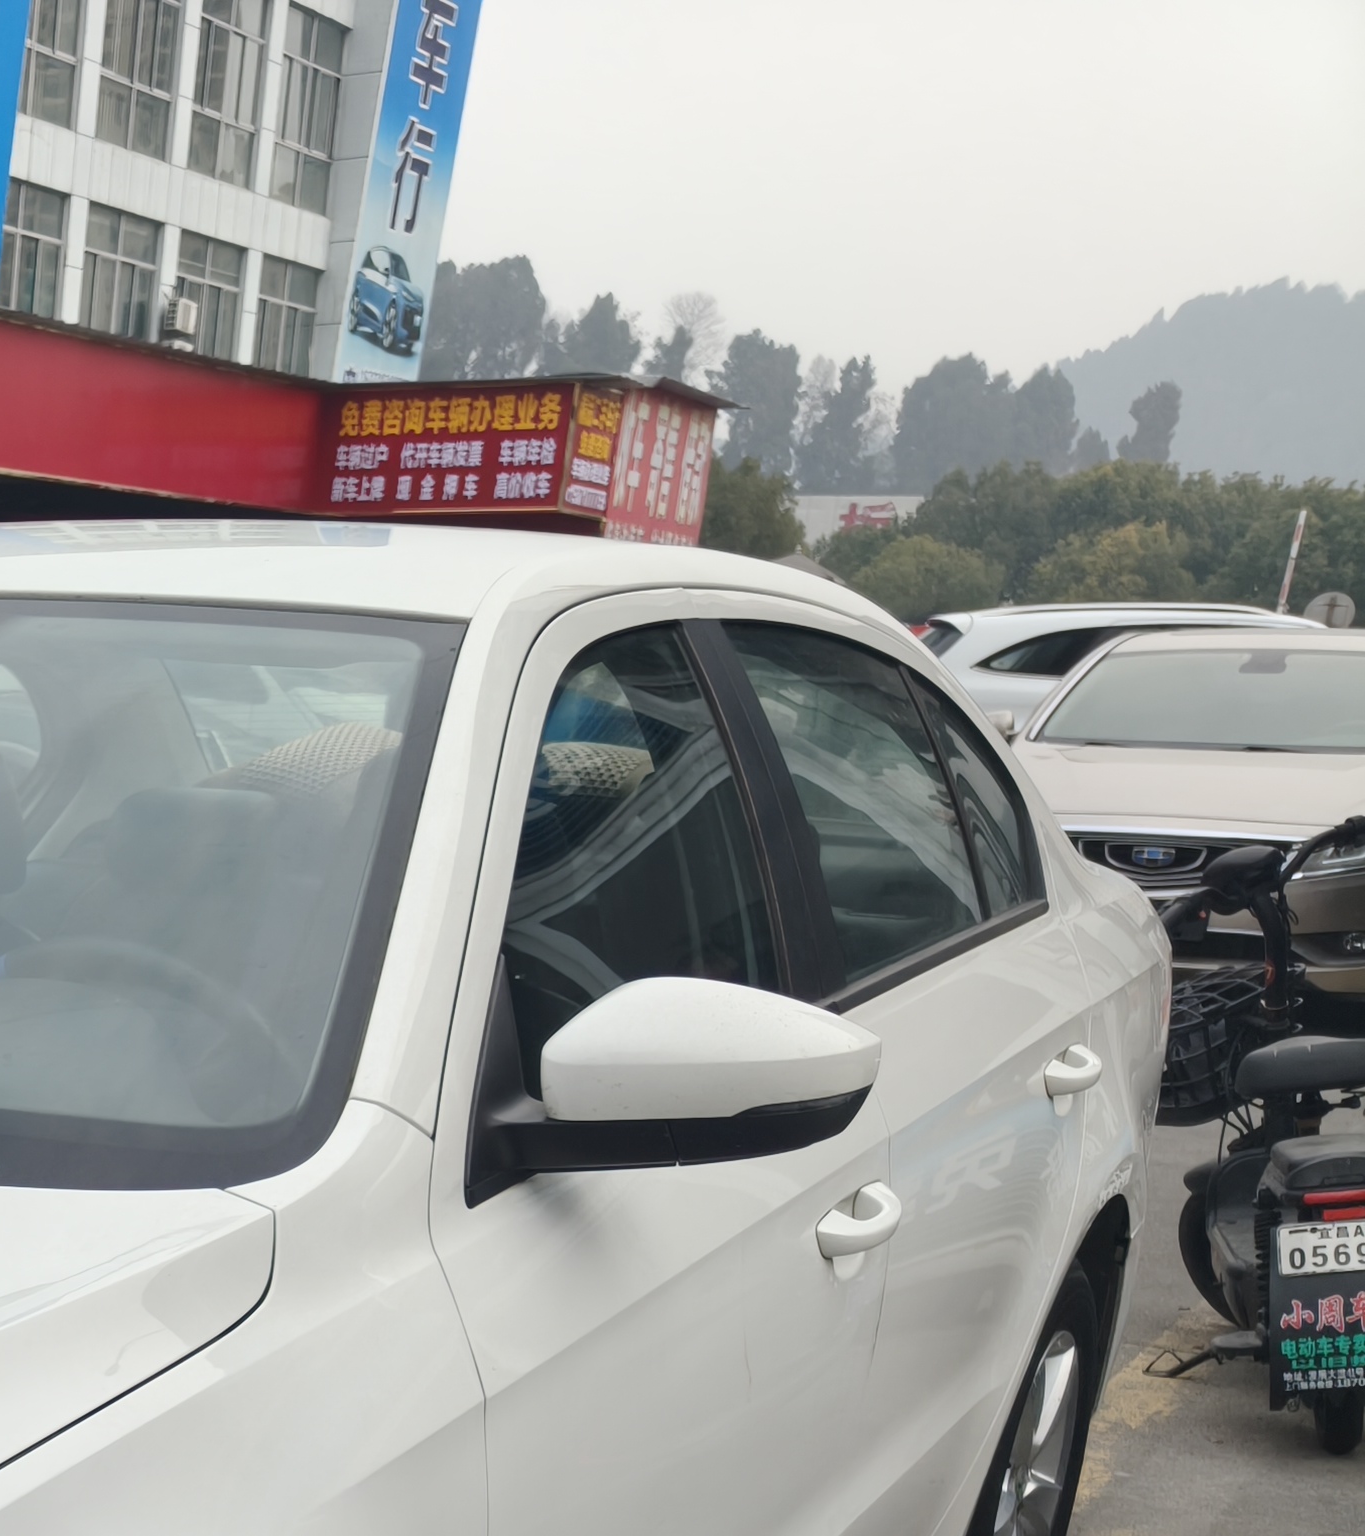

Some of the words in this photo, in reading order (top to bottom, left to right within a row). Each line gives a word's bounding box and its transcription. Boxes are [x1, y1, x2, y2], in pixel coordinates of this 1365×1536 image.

[339, 392, 562, 437] 免费咨询车辆办理业务
